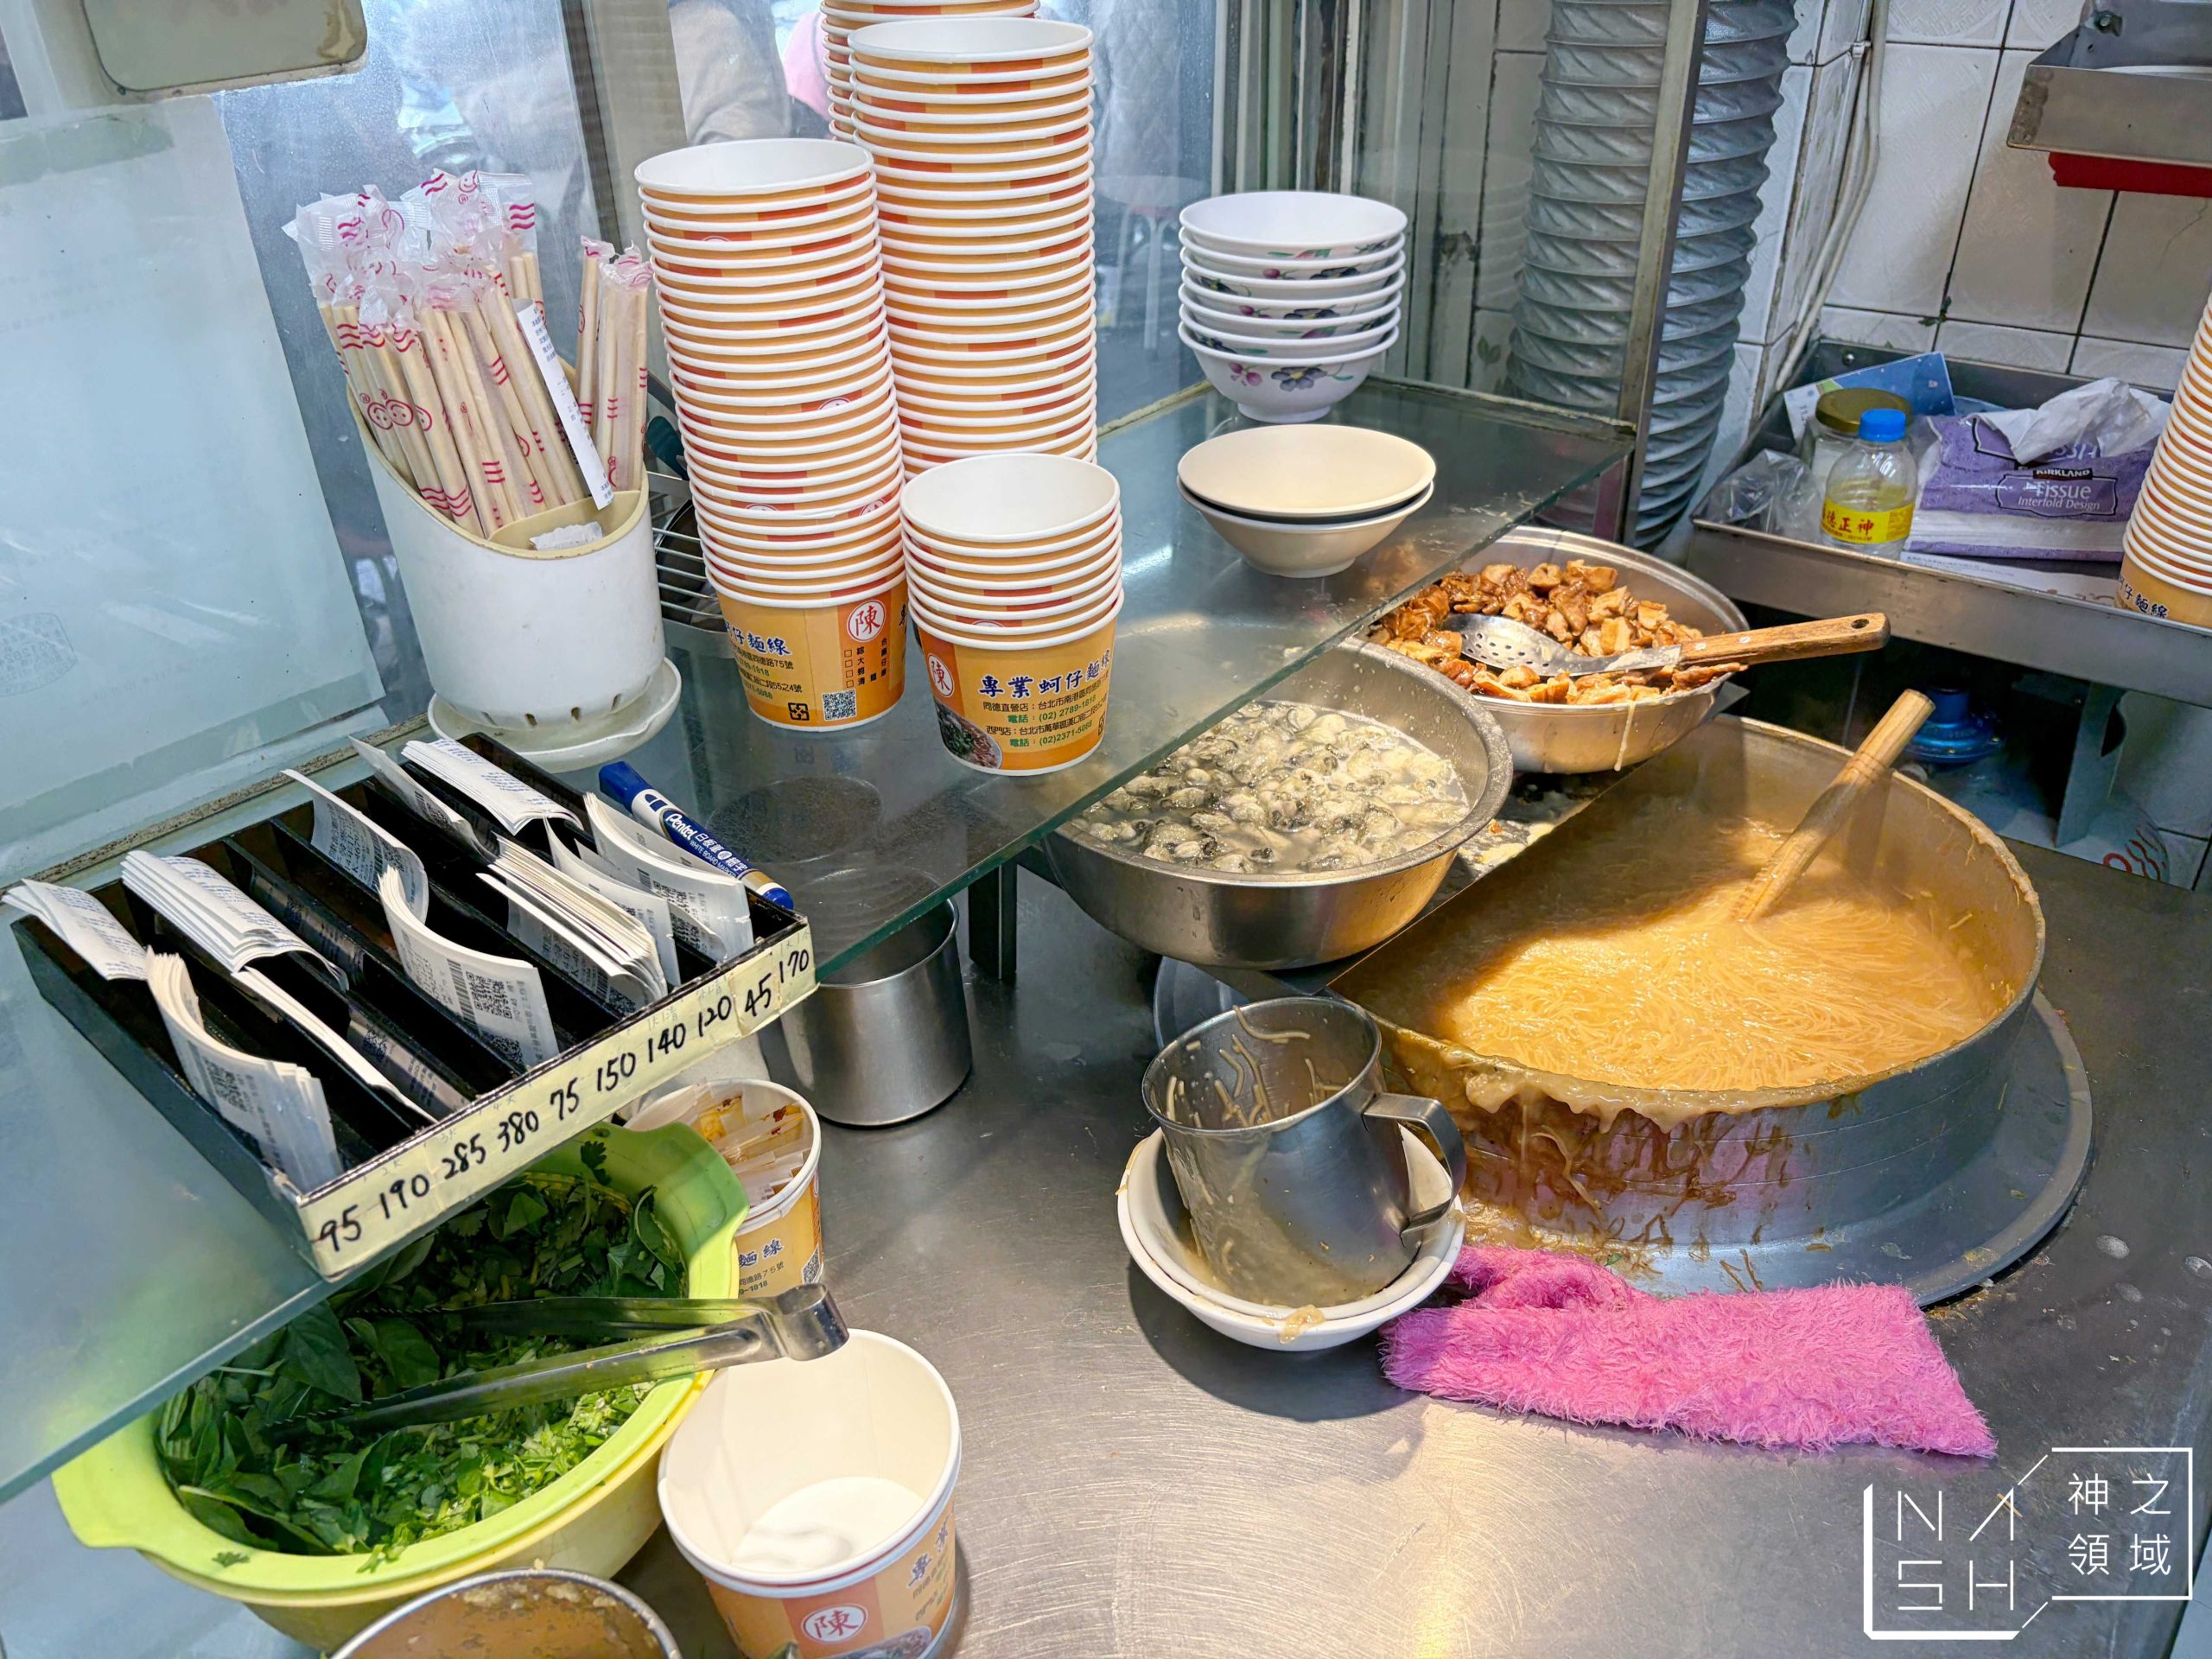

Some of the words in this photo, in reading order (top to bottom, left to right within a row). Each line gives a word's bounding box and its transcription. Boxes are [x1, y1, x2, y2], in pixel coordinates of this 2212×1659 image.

[2036, 467, 2090, 477] KIRKLAND
[2034, 481, 2091, 499] Tissue
[2018, 497, 2063, 509] Interfold
[2065, 499, 2100, 512] Design
[1823, 510, 1874, 536] 德正神
[855, 605, 880, 637] 陳
[931, 660, 950, 690] 陳
[979, 650, 1109, 698] 專業蚵仔麵線
[665, 813, 698, 841] Pentel
[690, 840, 704, 854] WHITE
[702, 850, 718, 865] BOARD
[320, 1205, 362, 1252] 95
[379, 1174, 429, 1219] 190
[442, 1133, 486, 1179] 285
[498, 1110, 539, 1153] 380
[550, 1077, 580, 1121] 75
[596, 1052, 636, 1092] 150
[648, 1022, 686, 1064] 140
[698, 995, 732, 1037] 120
[744, 972, 772, 1017] 45
[779, 949, 810, 984] 170
[813, 1610, 859, 1638] 陳
